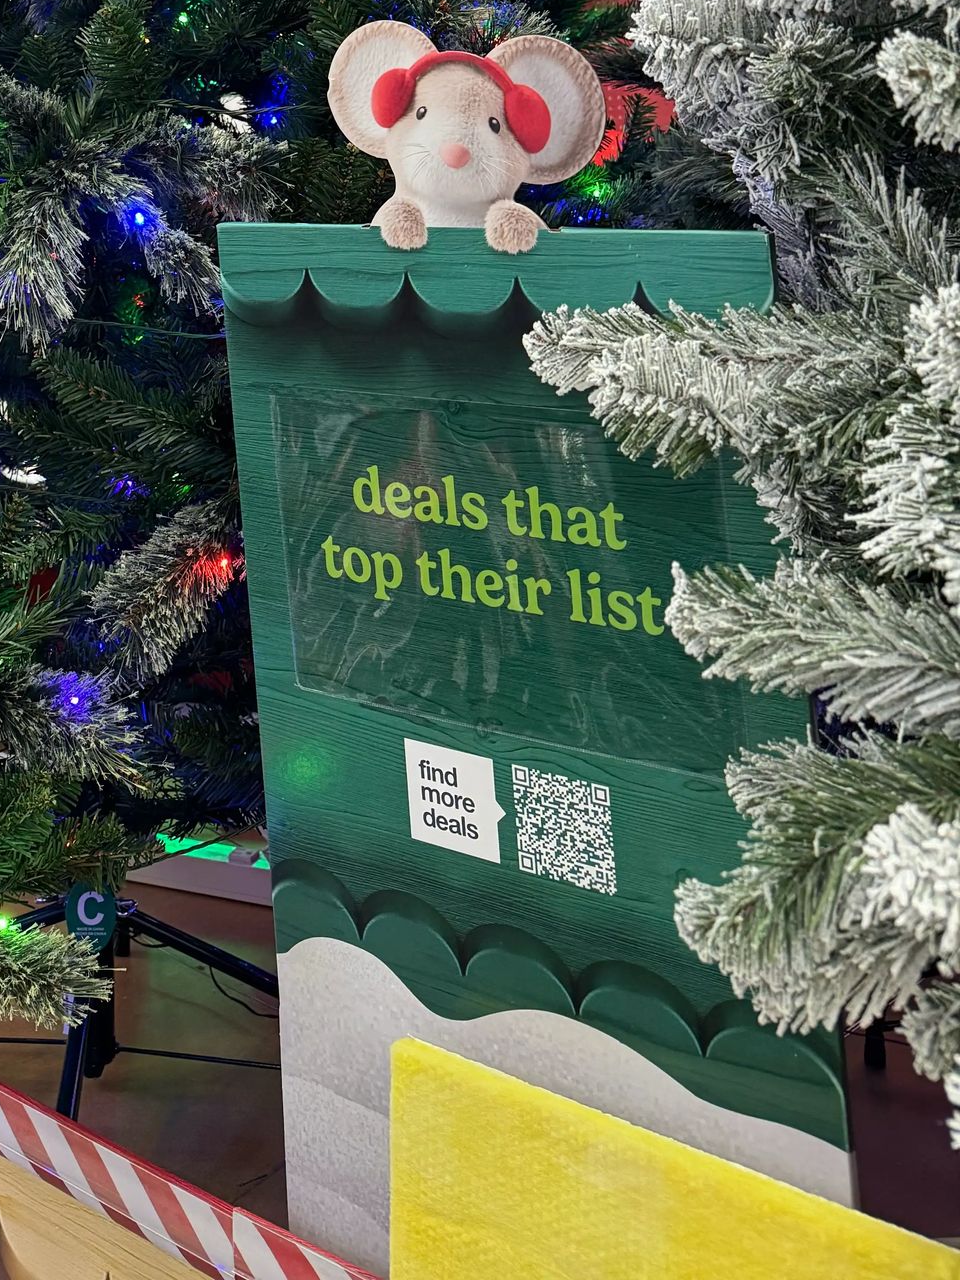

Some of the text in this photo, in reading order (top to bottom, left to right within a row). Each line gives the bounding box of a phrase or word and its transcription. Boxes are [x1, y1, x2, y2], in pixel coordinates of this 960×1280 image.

[353, 465, 627, 551] deals that
[321, 535, 665, 636] top their list
[418, 759, 458, 787] find
[421, 785, 475, 813] more
[423, 808, 479, 840] deals
[77, 890, 104, 926] C
